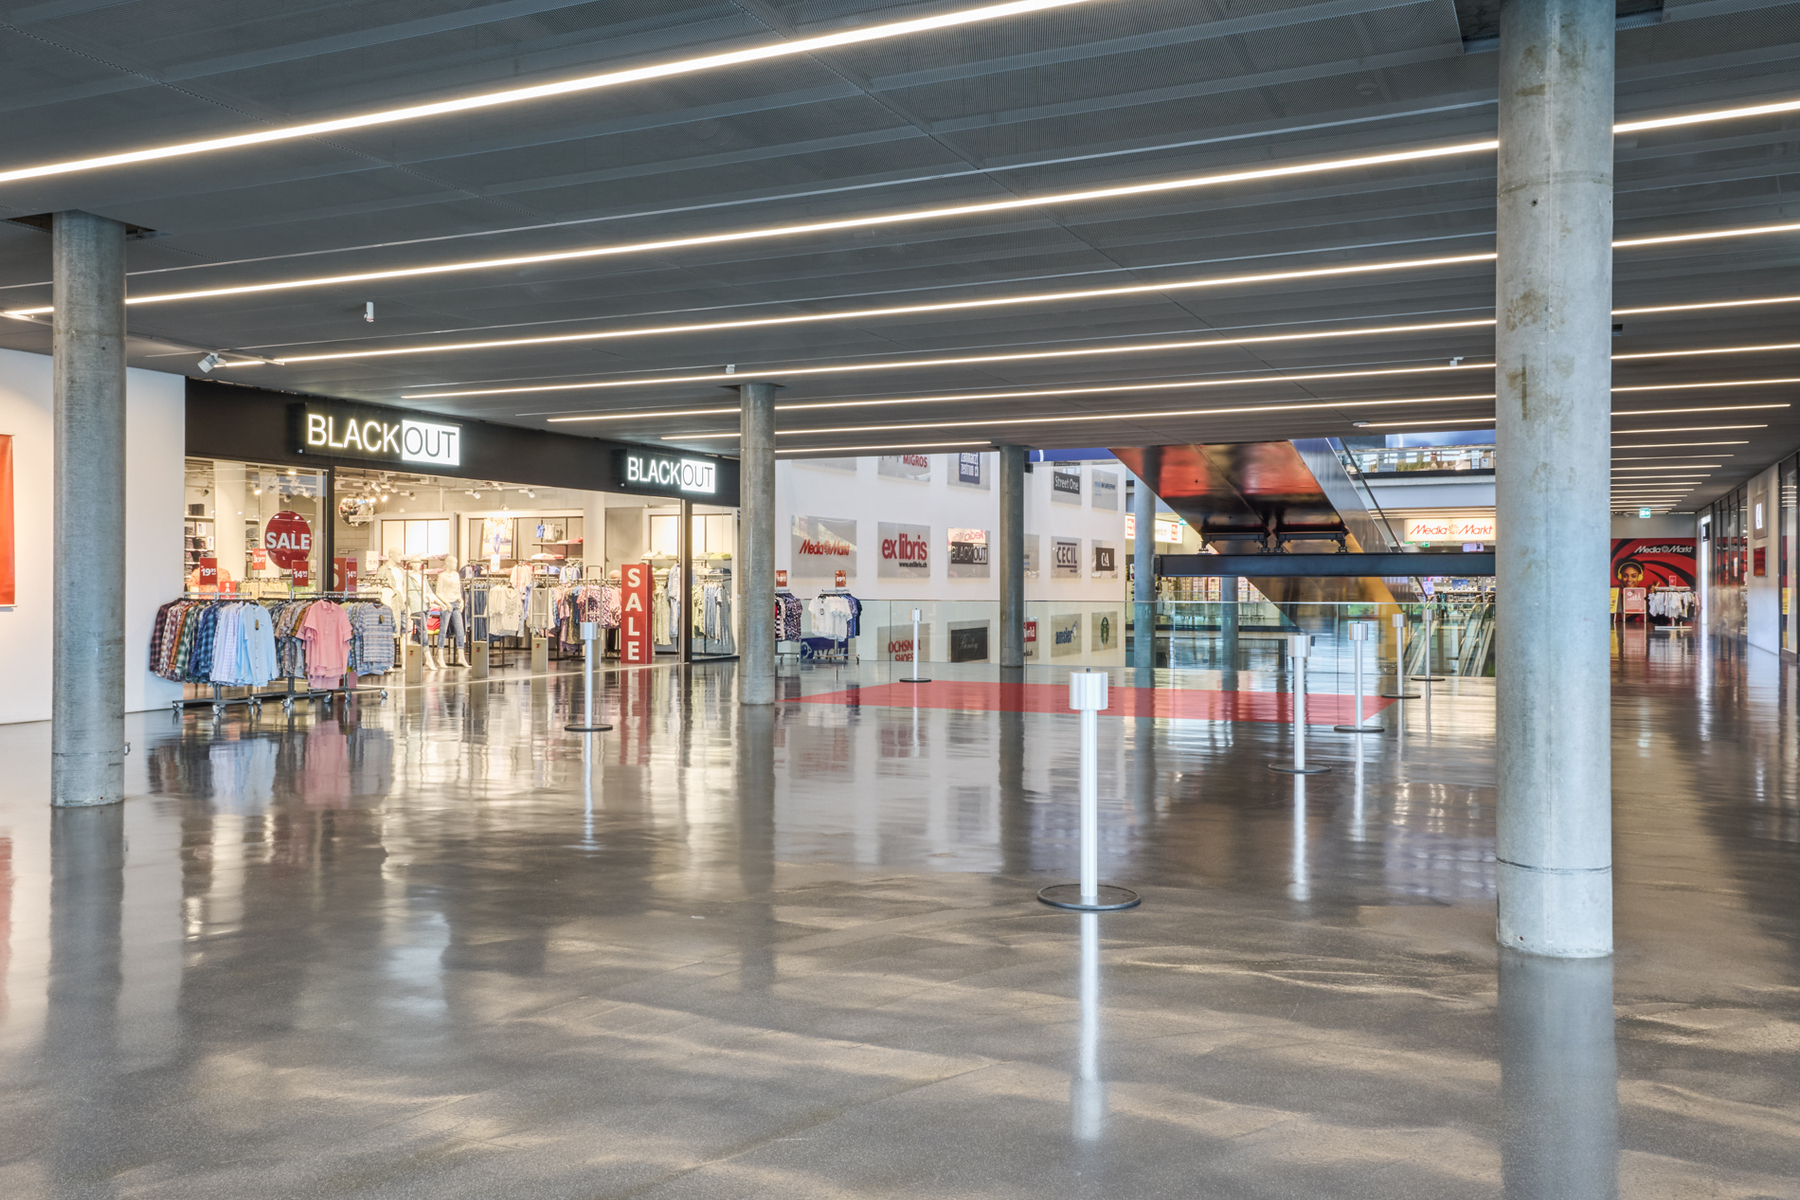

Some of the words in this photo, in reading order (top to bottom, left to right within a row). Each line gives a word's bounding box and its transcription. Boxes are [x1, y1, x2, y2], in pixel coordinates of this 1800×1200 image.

[307, 414, 458, 460] BLACKOUT
[903, 455, 928, 468] MIGROS
[627, 457, 714, 489] BLACKOUT
[1055, 476, 1069, 489] Street
[1070, 479, 1078, 491] One
[1410, 524, 1447, 535] Media
[1458, 524, 1493, 535] Markt
[266, 532, 310, 550] SALE
[799, 539, 823, 555] Media
[831, 539, 850, 556] Markt
[882, 538, 897, 559] ex
[899, 533, 927, 561] libris
[1634, 545, 1661, 553] Media
[952, 546, 987, 561] BLACKOUT
[1057, 547, 1077, 564] CECIL
[625, 568, 642, 661] SALE
[1055, 627, 1074, 644] amsler
